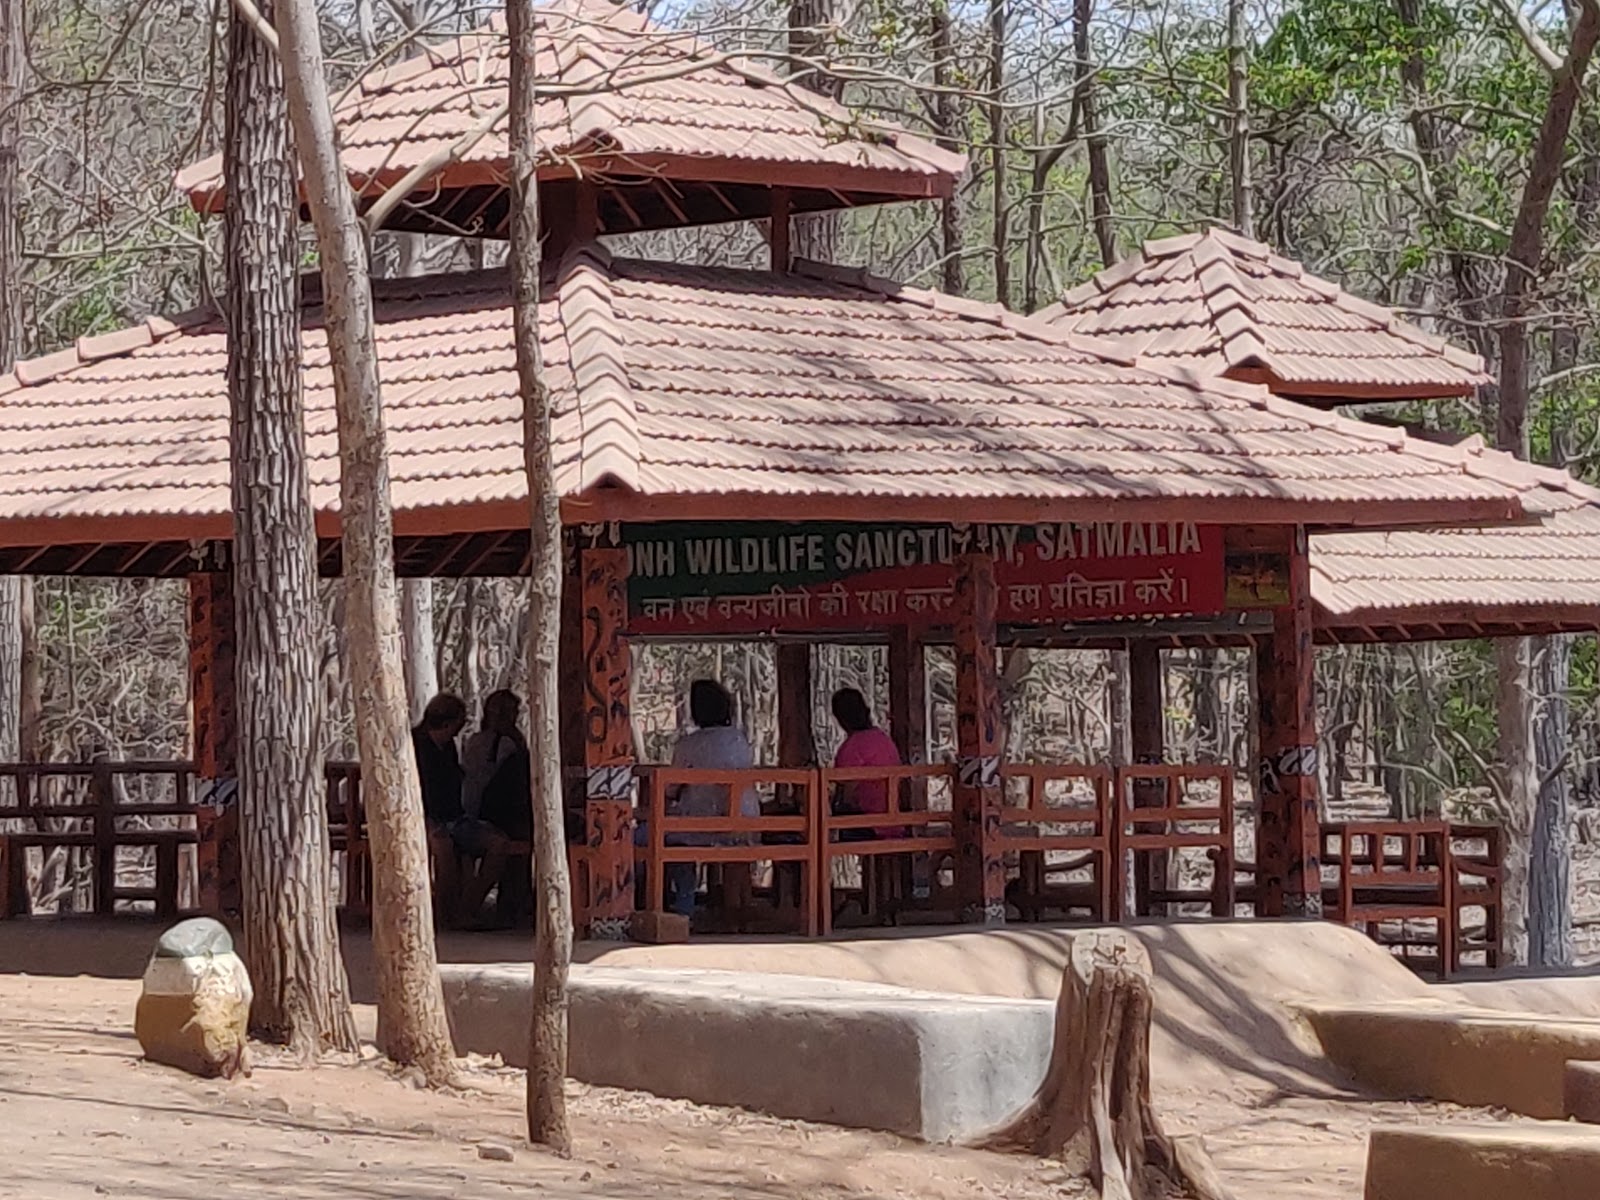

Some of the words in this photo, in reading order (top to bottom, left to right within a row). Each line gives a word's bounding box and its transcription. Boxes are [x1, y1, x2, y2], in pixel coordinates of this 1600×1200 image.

[685, 534, 825, 575] WILDLIFE
[1036, 521, 1201, 561] SATMALIA
[642, 597, 675, 622] वन
[680, 588, 711, 625] एवं
[817, 582, 849, 617] की
[855, 588, 898, 614] रक्षा
[1008, 584, 1041, 612] हम
[1047, 570, 1126, 610] प्रतिज्ञा
